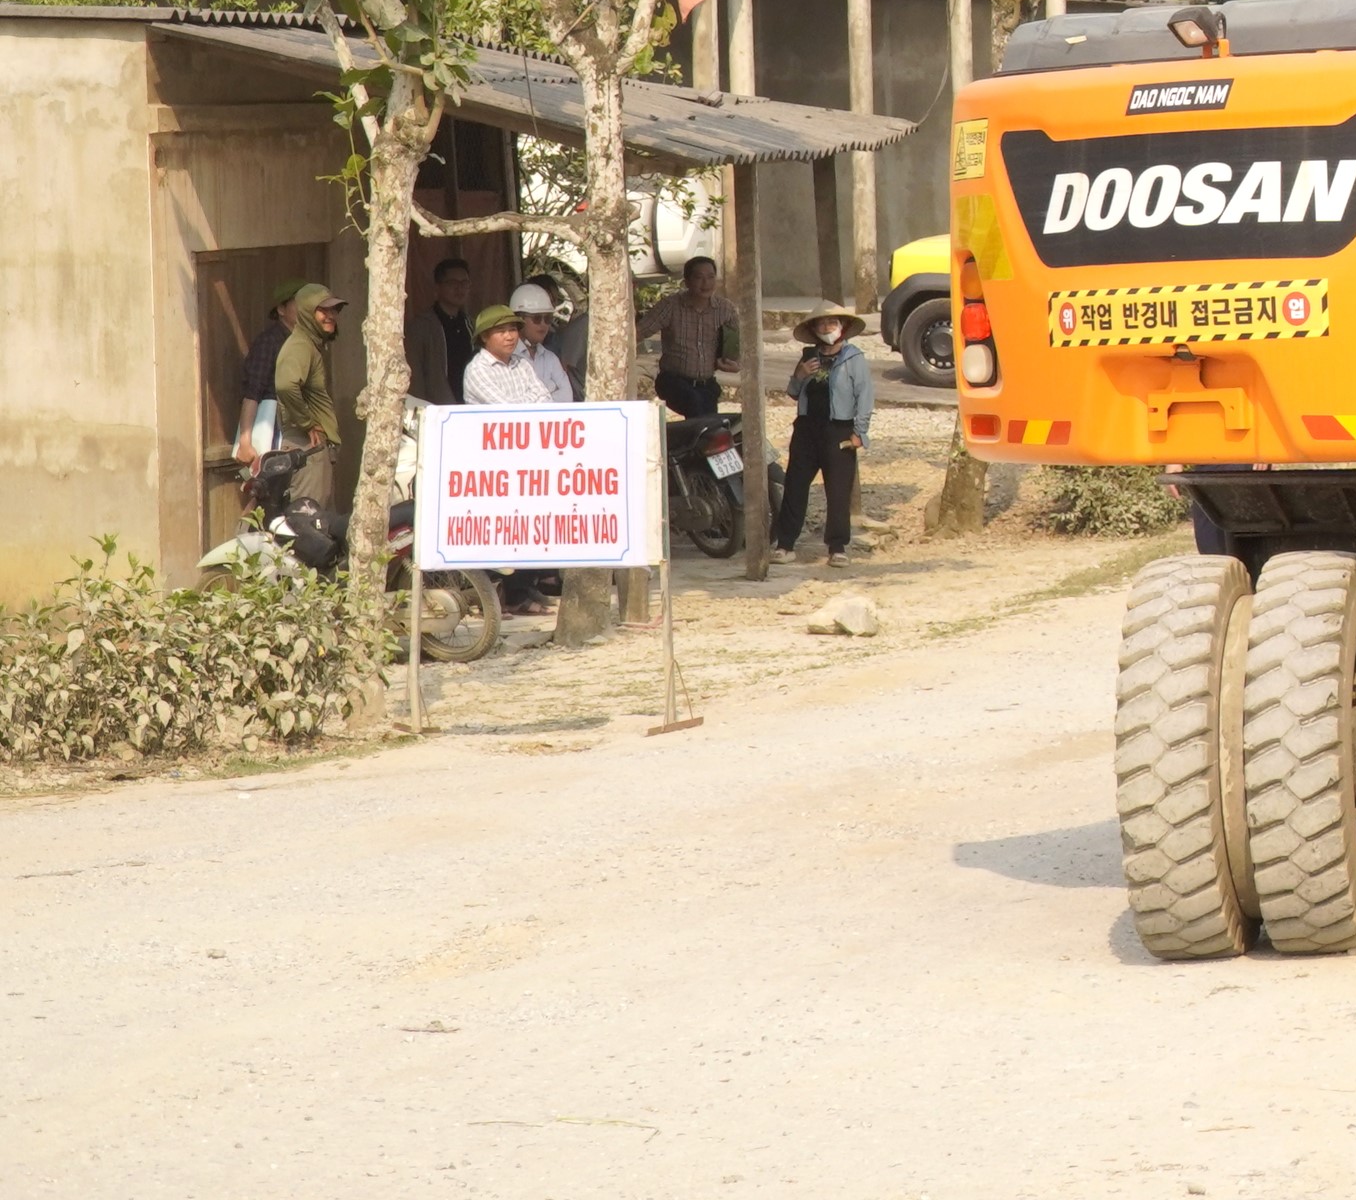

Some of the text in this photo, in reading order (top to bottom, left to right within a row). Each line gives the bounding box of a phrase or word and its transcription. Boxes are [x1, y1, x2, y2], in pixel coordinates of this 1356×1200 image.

[1129, 84, 1230, 110] DAO NGOC NAM
[1081, 303, 1112, 332] 작업
[1123, 300, 1178, 330] 반경내
[1191, 296, 1277, 327] 접근금지
[482, 418, 586, 456] KHU VỰC
[449, 463, 619, 498] ĐANG THI CÔNG
[447, 503, 618, 552] KHÔNG PHẬN SỰ MIỄN VÀO
